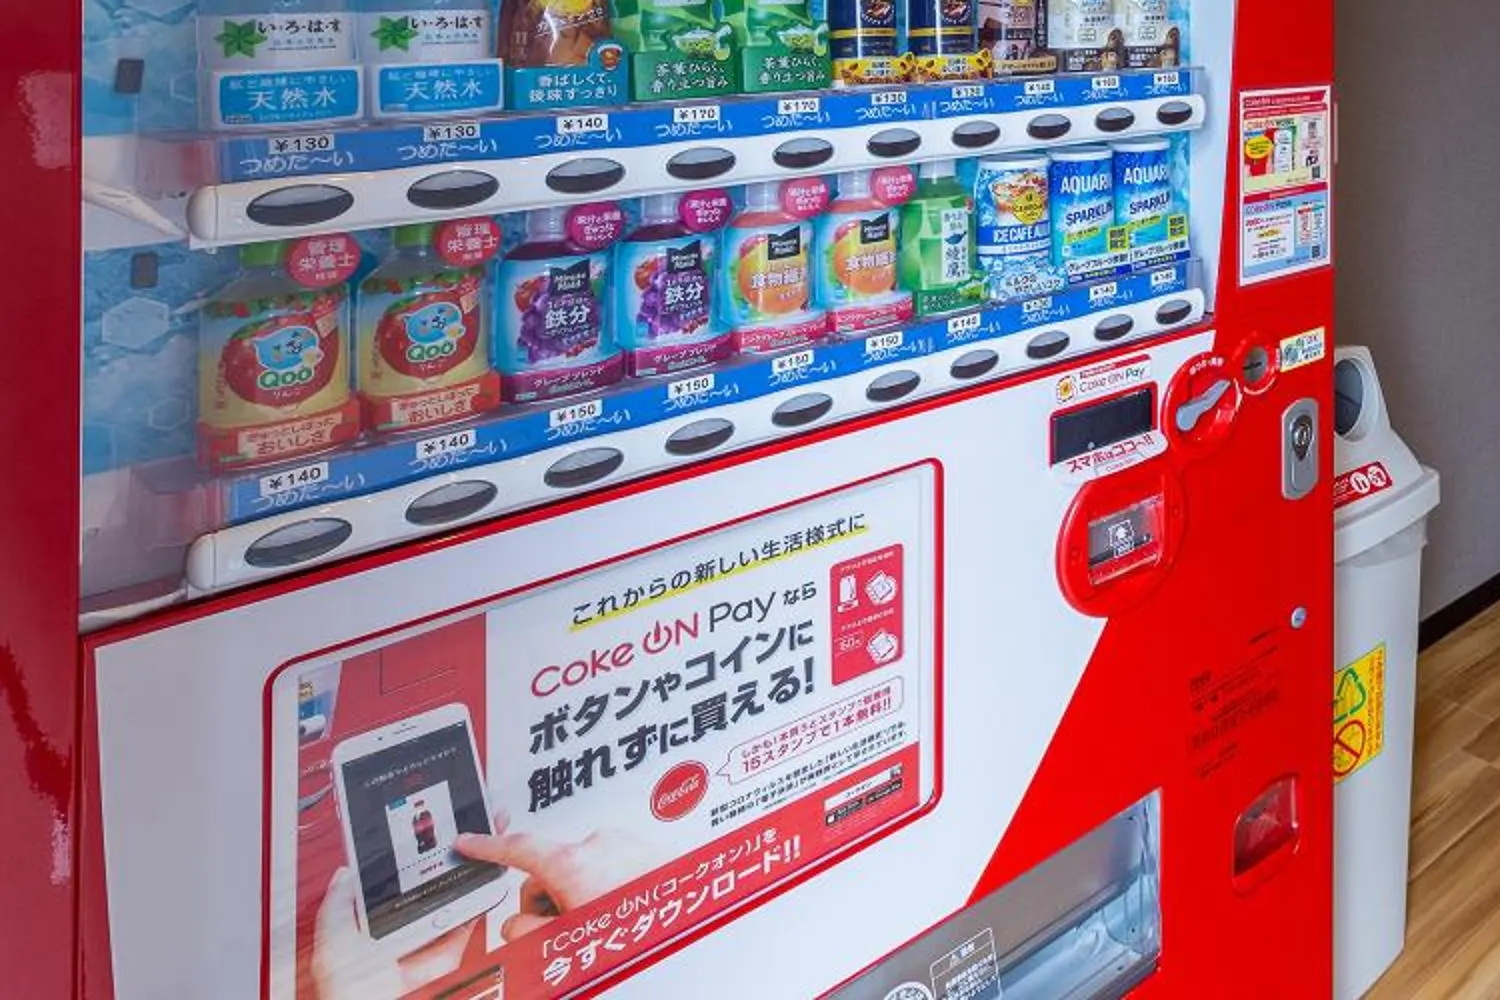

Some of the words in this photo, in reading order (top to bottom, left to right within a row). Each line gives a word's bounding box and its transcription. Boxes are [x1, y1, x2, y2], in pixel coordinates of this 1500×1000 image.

[246, 86, 338, 111] 天然水
[405, 80, 484, 101] 天然水
[428, 125, 477, 140] ¥130
[562, 117, 604, 131] ¥140
[274, 135, 330, 153] ¥130
[993, 228, 1009, 243] ICE
[665, 282, 705, 304] 鉄分
[545, 306, 591, 329] 鉄分
[407, 340, 455, 362] Qoo
[259, 366, 313, 389] Qoo
[1079, 377, 1107, 393] Coke
[1125, 366, 1146, 380] Pay
[423, 434, 470, 455] ¥140
[268, 467, 322, 489] ¥140
[573, 513, 865, 625] これからの新しい生活様式に
[531, 640, 635, 697] Coke
[708, 591, 776, 633] Pay
[784, 582, 818, 606] なら
[528, 620, 814, 756] ボタンやコインに
[527, 657, 814, 813] 触れずに買える!
